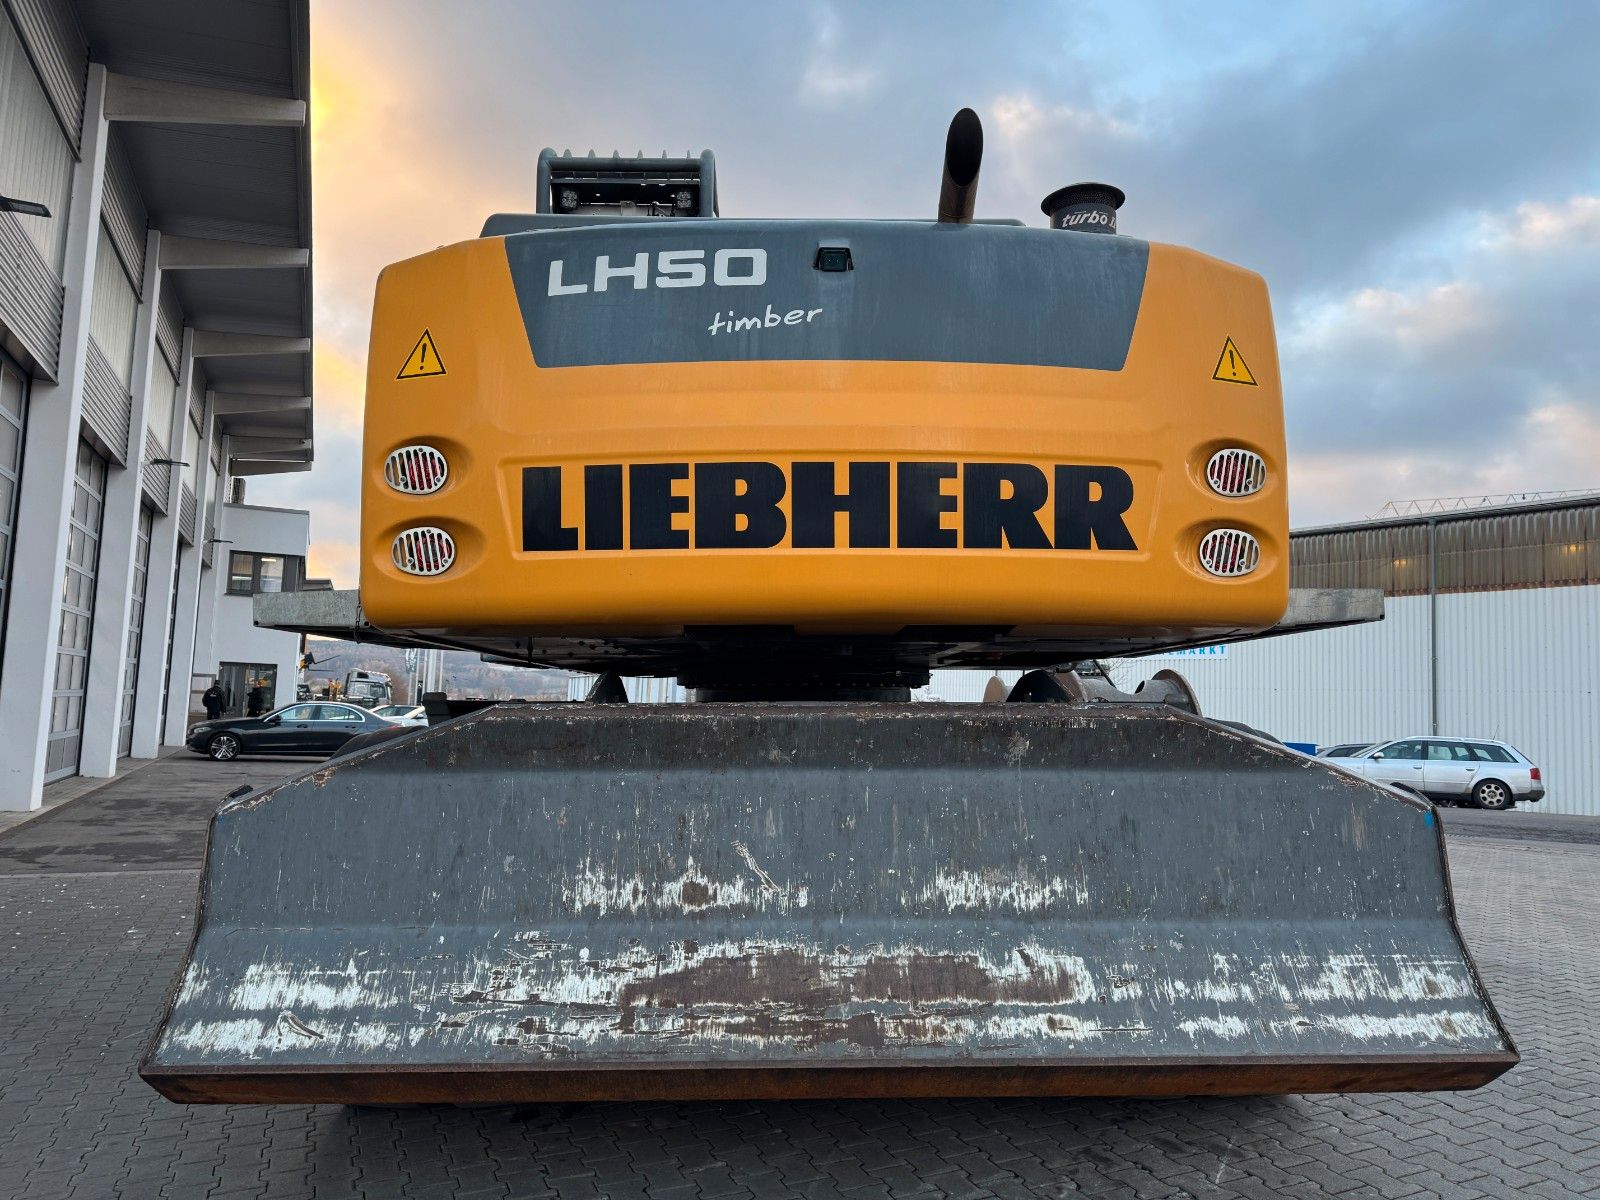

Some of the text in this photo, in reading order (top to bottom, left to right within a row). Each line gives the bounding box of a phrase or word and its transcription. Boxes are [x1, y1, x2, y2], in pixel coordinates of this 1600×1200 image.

[1062, 211, 1107, 227] turbo
[547, 248, 768, 297] LH50
[707, 304, 824, 336] timber
[522, 461, 1138, 552] LIEBHERR
